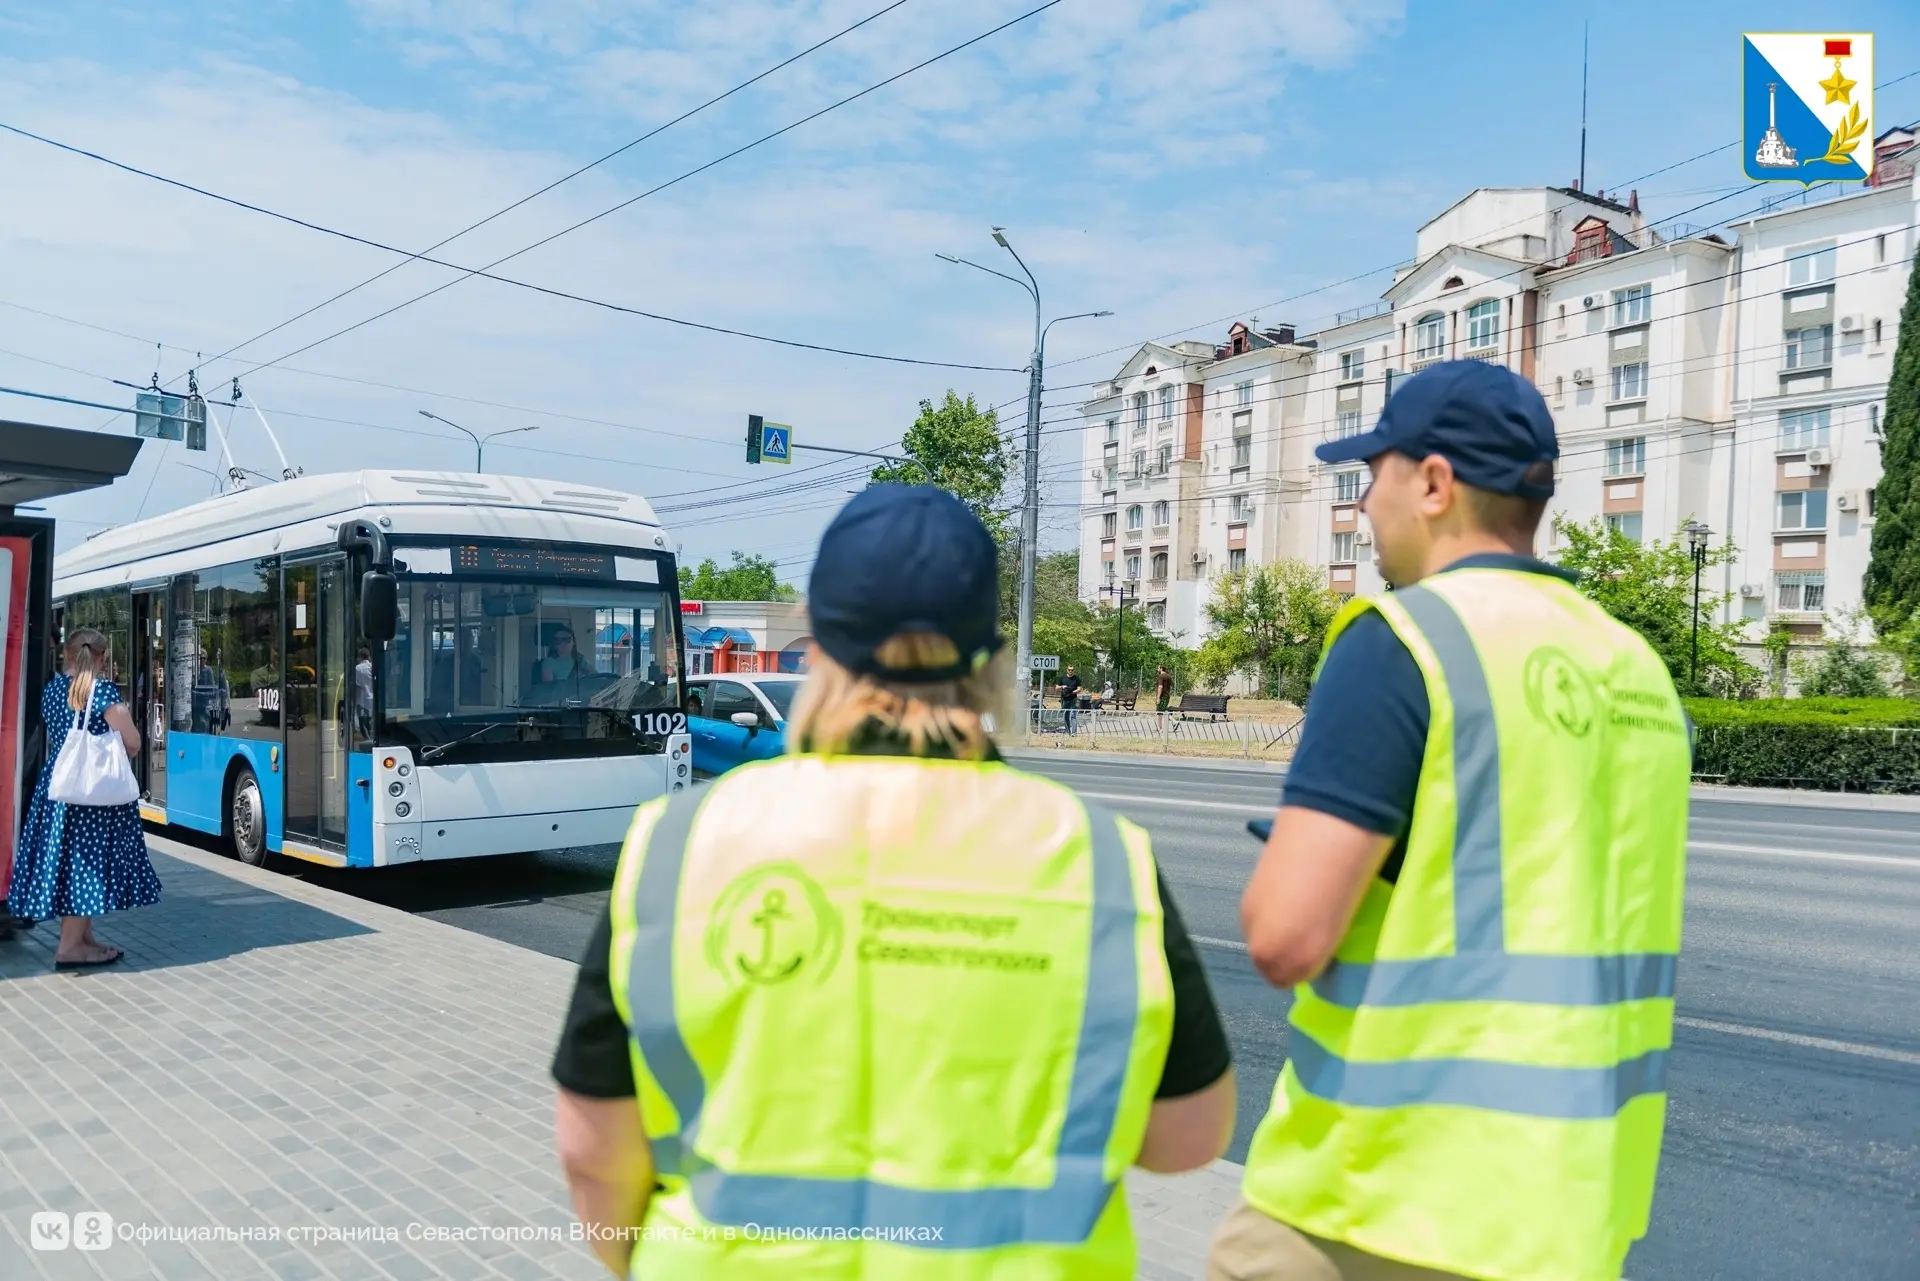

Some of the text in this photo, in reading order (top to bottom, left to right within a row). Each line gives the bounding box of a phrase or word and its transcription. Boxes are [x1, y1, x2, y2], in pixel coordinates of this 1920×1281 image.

[1034, 657, 1056, 668] СТОП
[257, 688, 279, 711] 1102
[631, 712, 687, 735] 1102
